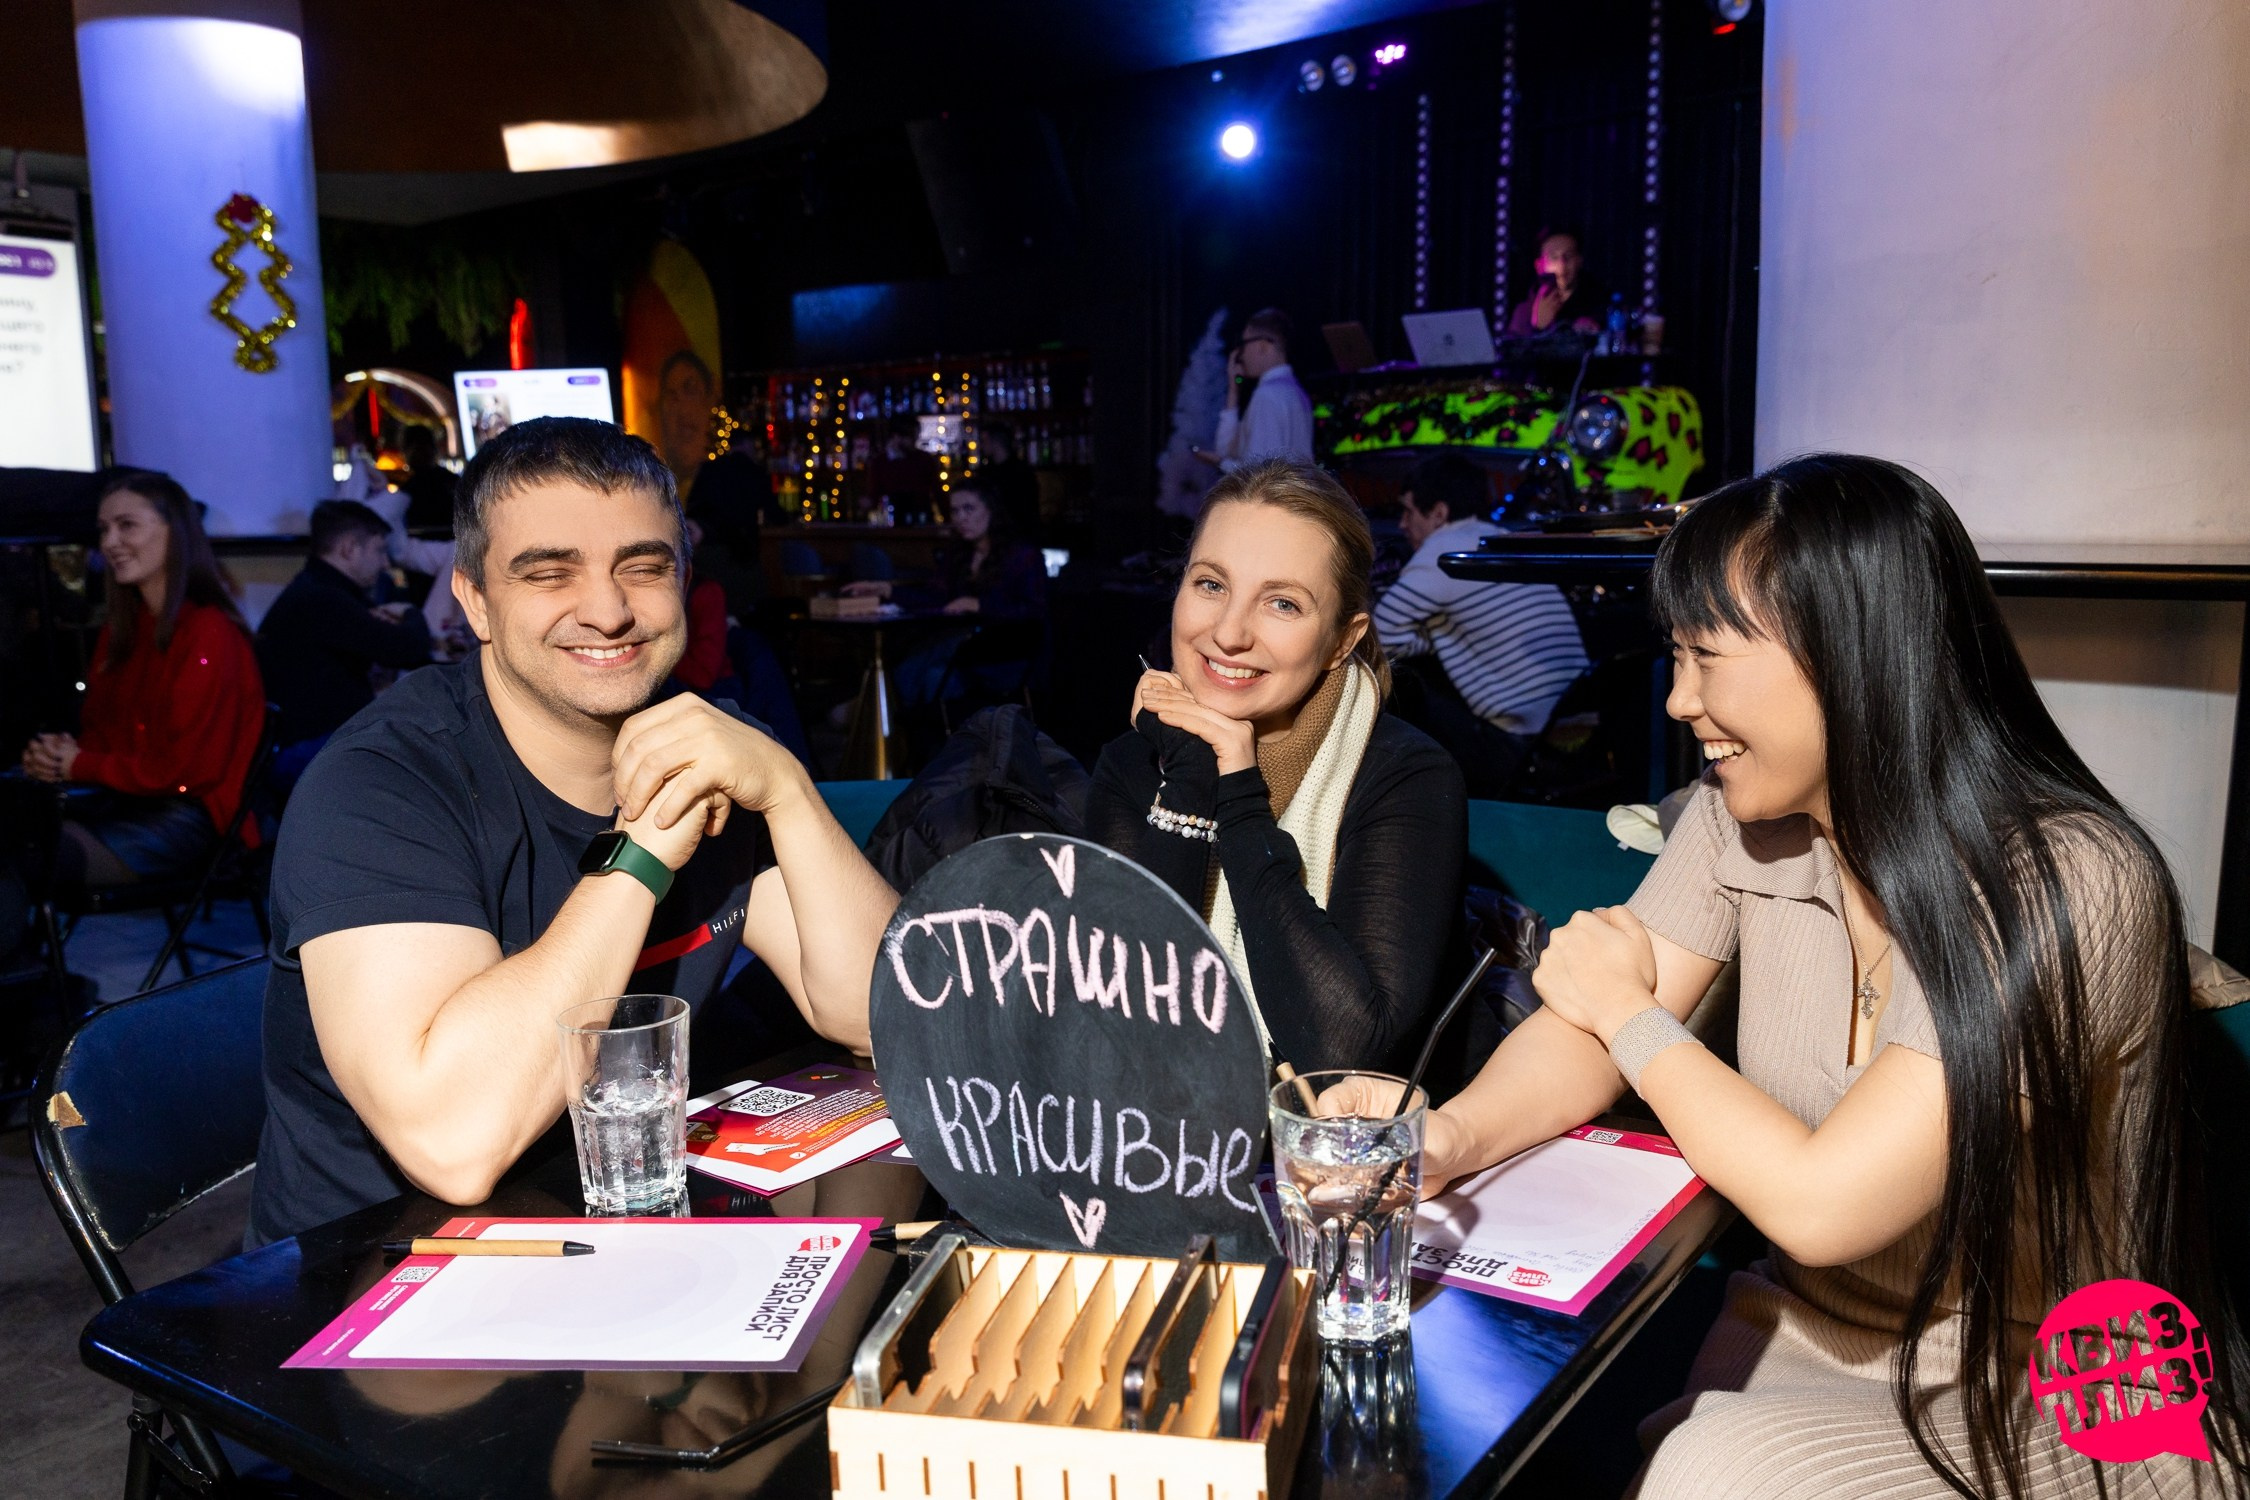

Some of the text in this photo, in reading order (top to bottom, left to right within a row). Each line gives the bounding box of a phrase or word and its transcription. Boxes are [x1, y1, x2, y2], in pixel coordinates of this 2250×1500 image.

[712, 908, 745, 934] HILFI
[890, 904, 1229, 1033] СТРАШНО
[926, 1076, 1257, 1212] КРАСИВЫЕ
[1411, 1242, 1448, 1257] ЗА
[1411, 1252, 1496, 1278] ПРОСТ
[1453, 1252, 1508, 1270] ДЛЯ
[744, 1255, 810, 1331] ДЛЯ ЗАПИСИ
[785, 1256, 832, 1304] ПРОСТО
[762, 1308, 800, 1341] ЛИСТ
